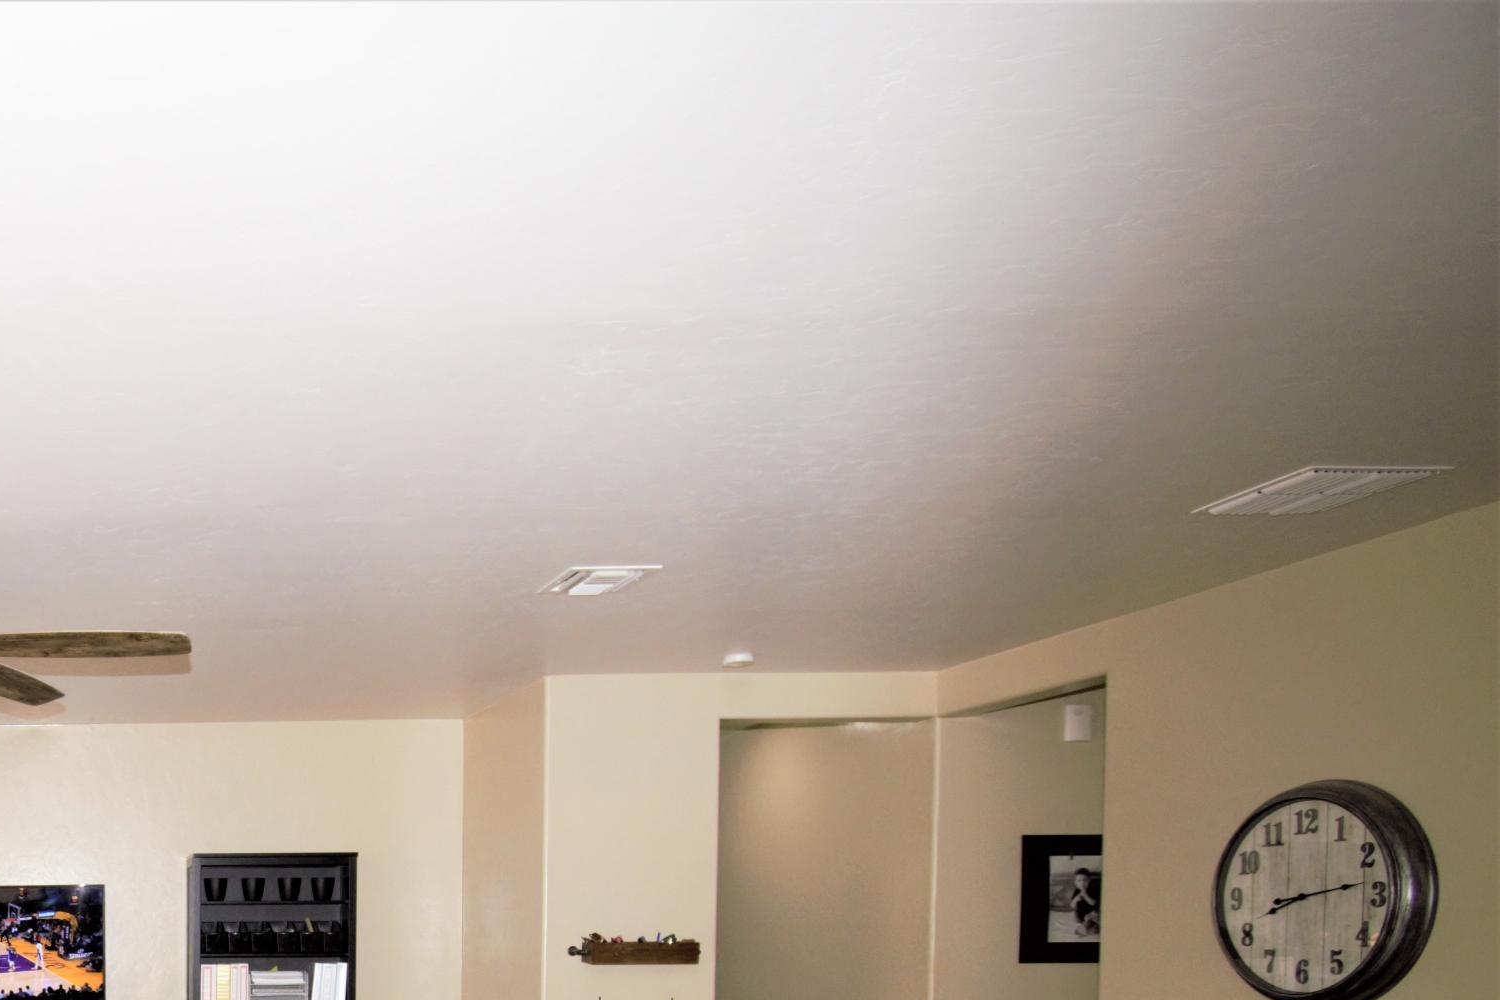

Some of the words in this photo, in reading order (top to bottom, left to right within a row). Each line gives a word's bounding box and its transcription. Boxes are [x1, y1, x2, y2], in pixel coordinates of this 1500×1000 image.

[1293, 808, 1319, 835] 12
[1333, 816, 1347, 842] 1
[1261, 822, 1284, 847] 11
[1238, 850, 1260, 875] 10
[1360, 842, 1375, 868] 2
[1230, 887, 1243, 911] 9
[1370, 881, 1387, 908] 3
[1241, 923, 1254, 946] 8
[1356, 921, 1369, 948] 4
[1263, 949, 1276, 973] 7
[1295, 959, 1309, 984] 6
[1330, 950, 1344, 975] 5
